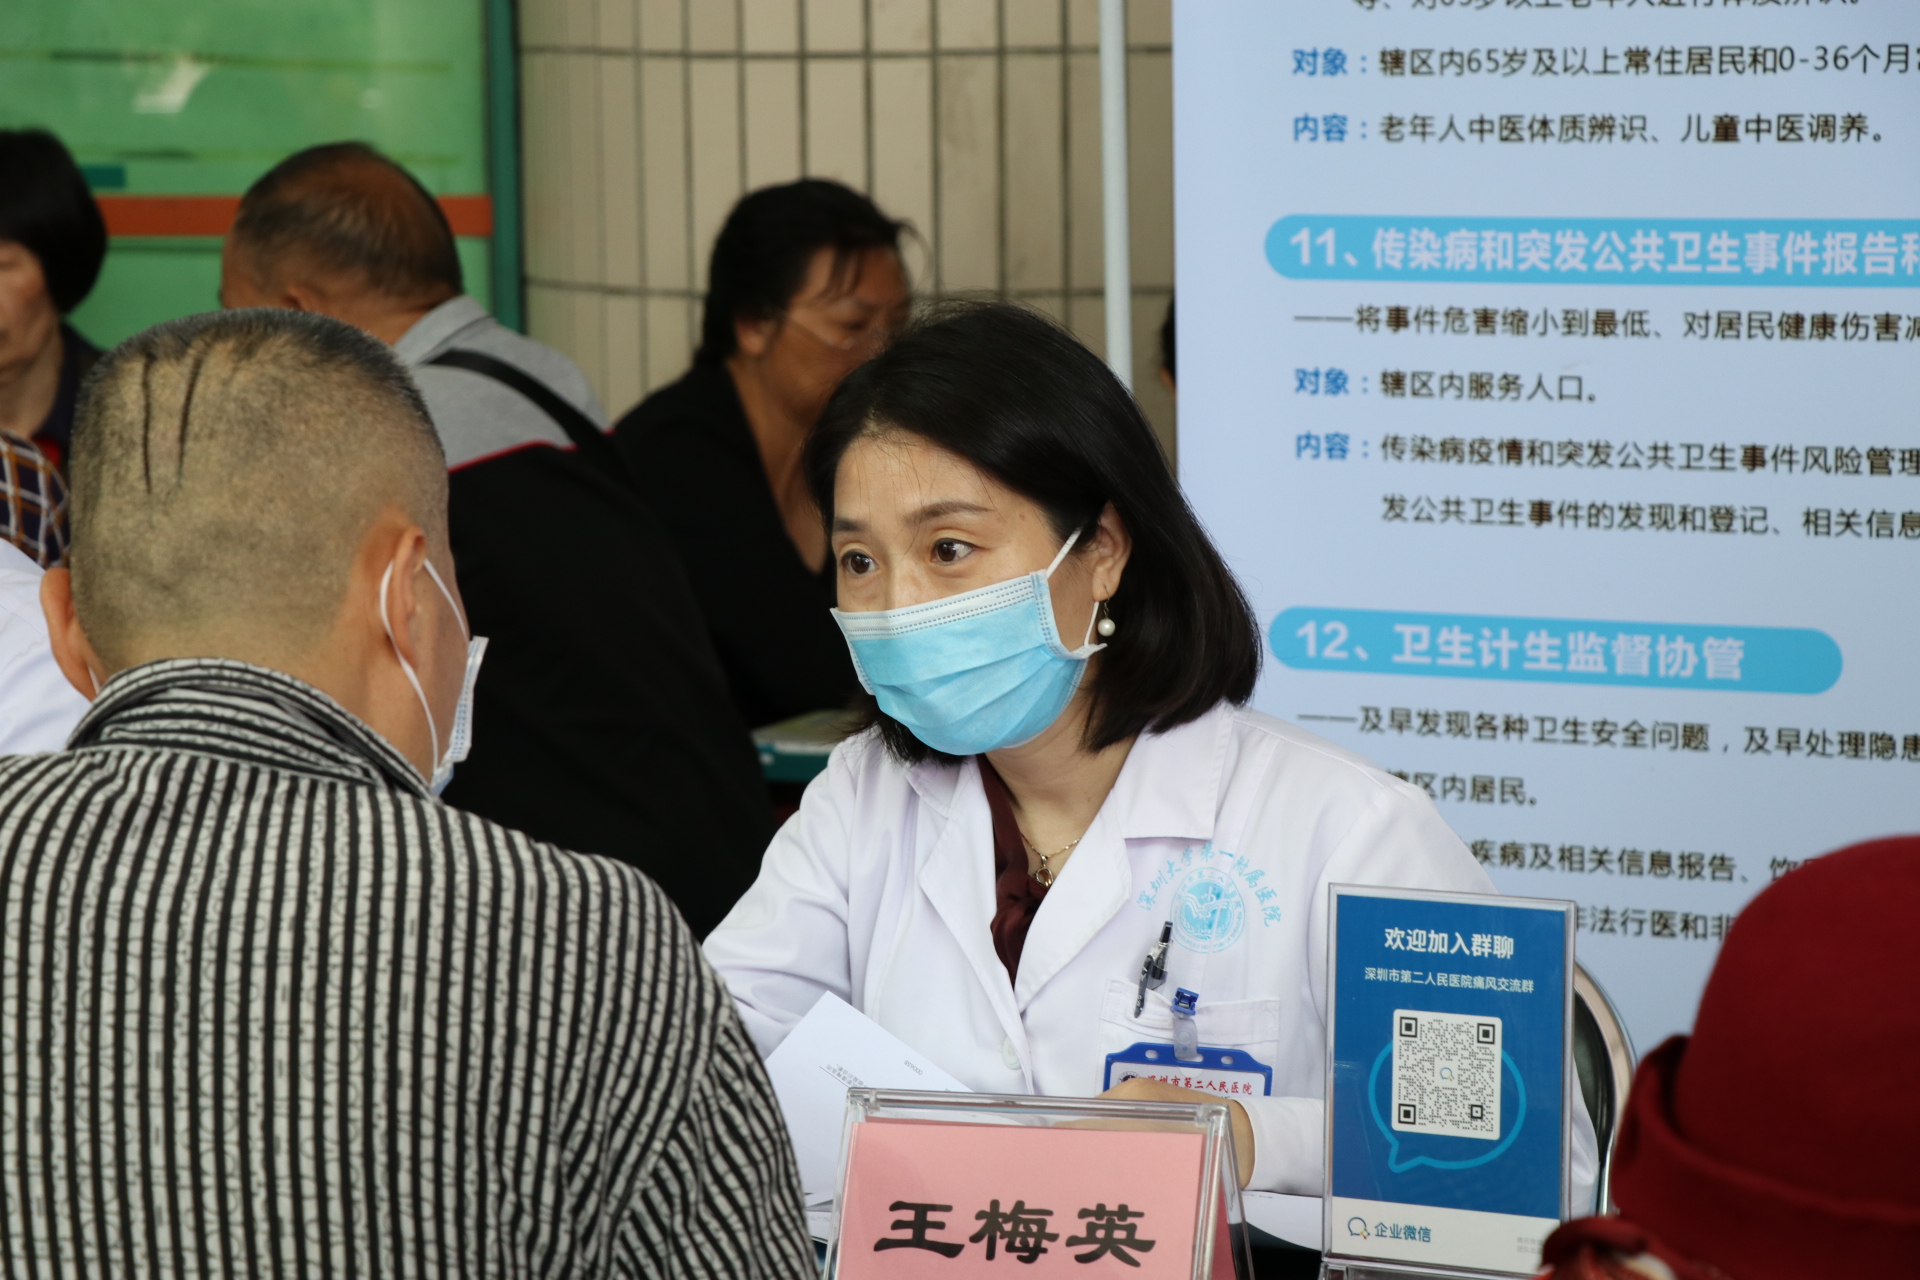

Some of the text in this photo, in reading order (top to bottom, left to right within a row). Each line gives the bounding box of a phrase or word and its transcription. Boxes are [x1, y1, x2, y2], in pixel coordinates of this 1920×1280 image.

[1293, 44, 1920, 77] 对象：辖区内65岁及以上常住居民和0-36个月
[1469, 838, 1820, 883] 疾病及相关信息报告、饮
[1384, 926, 1515, 960] 欢迎加入群聊
[1364, 966, 1535, 994] 深圳市第二人民医院痛风交流群
[873, 1199, 1156, 1268] 王梅英
[1374, 1221, 1432, 1243] 企业微信
